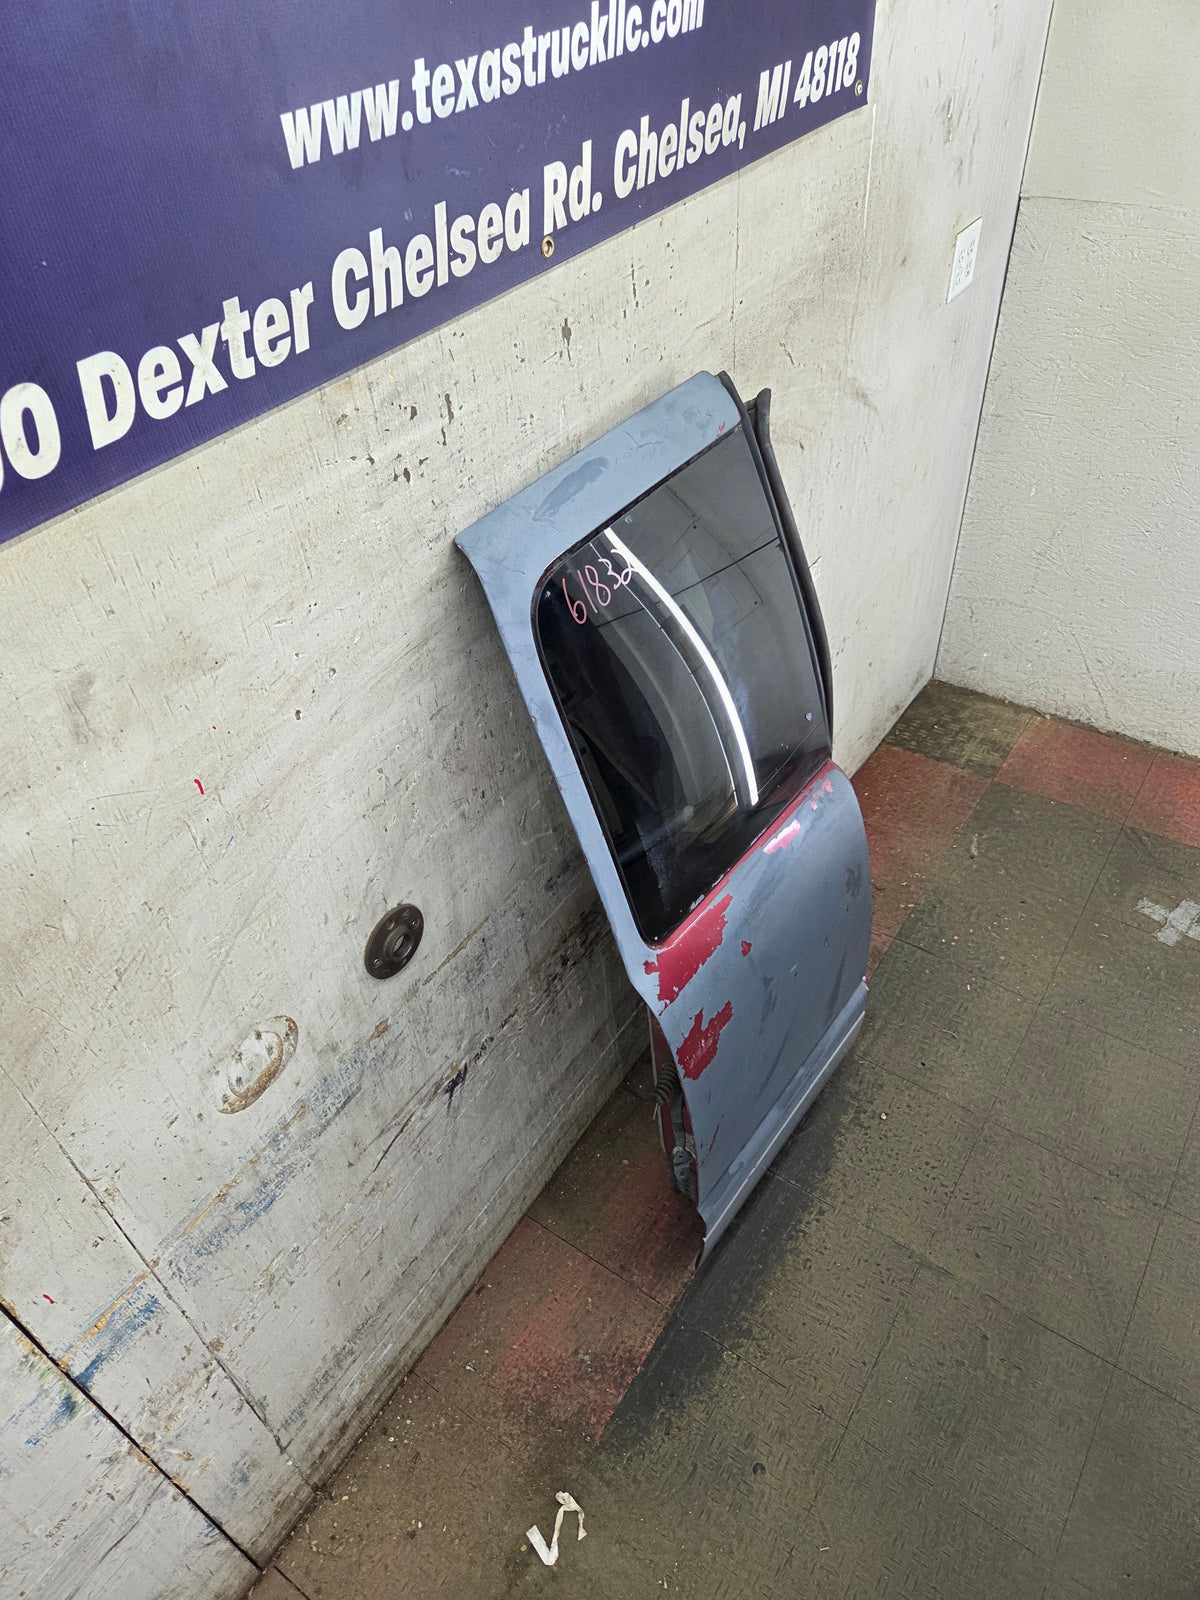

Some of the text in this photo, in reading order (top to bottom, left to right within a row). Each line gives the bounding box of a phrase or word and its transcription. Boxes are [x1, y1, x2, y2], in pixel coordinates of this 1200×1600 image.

[279, 0, 705, 170] www.texastruckllc.com
[0, 31, 861, 493] 0 Dexter Chelsea Rd. Chelsea, MI 48118
[562, 548, 639, 625] 61832
